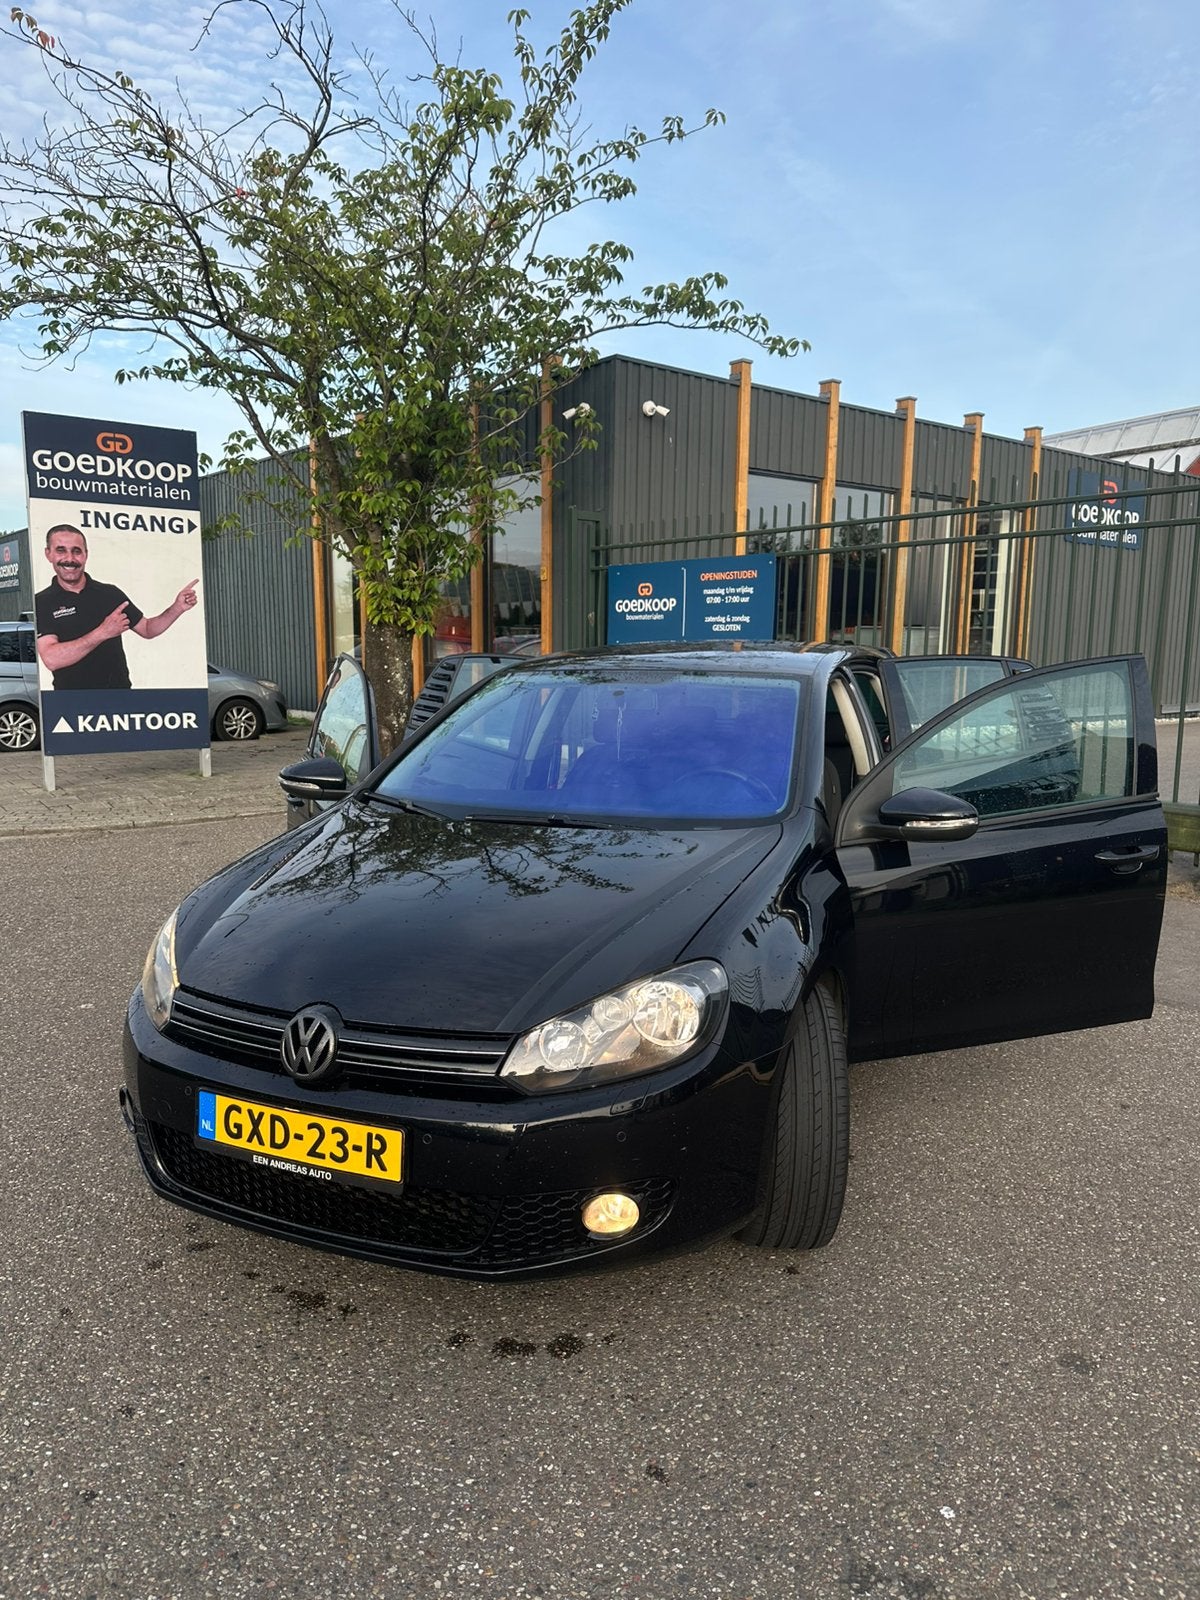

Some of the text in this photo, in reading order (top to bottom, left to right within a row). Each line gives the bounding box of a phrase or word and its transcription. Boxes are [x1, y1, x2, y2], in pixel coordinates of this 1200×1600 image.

[36, 472, 191, 501] bouwmaterialen
[80, 510, 184, 534] INGANG
[703, 587, 725, 595] maandag
[736, 585, 754, 595] vrijdag
[725, 595, 740, 603] 17:00
[625, 613, 665, 621] bouwmaterialen
[704, 615, 726, 623] zaterdag
[731, 615, 750, 623] zondag
[78, 712, 199, 733] KANTOOR
[201, 1120, 214, 1132] NL
[223, 1104, 388, 1172] GXD-23-R
[252, 1154, 332, 1180] EEN ANDREAS AUTO
